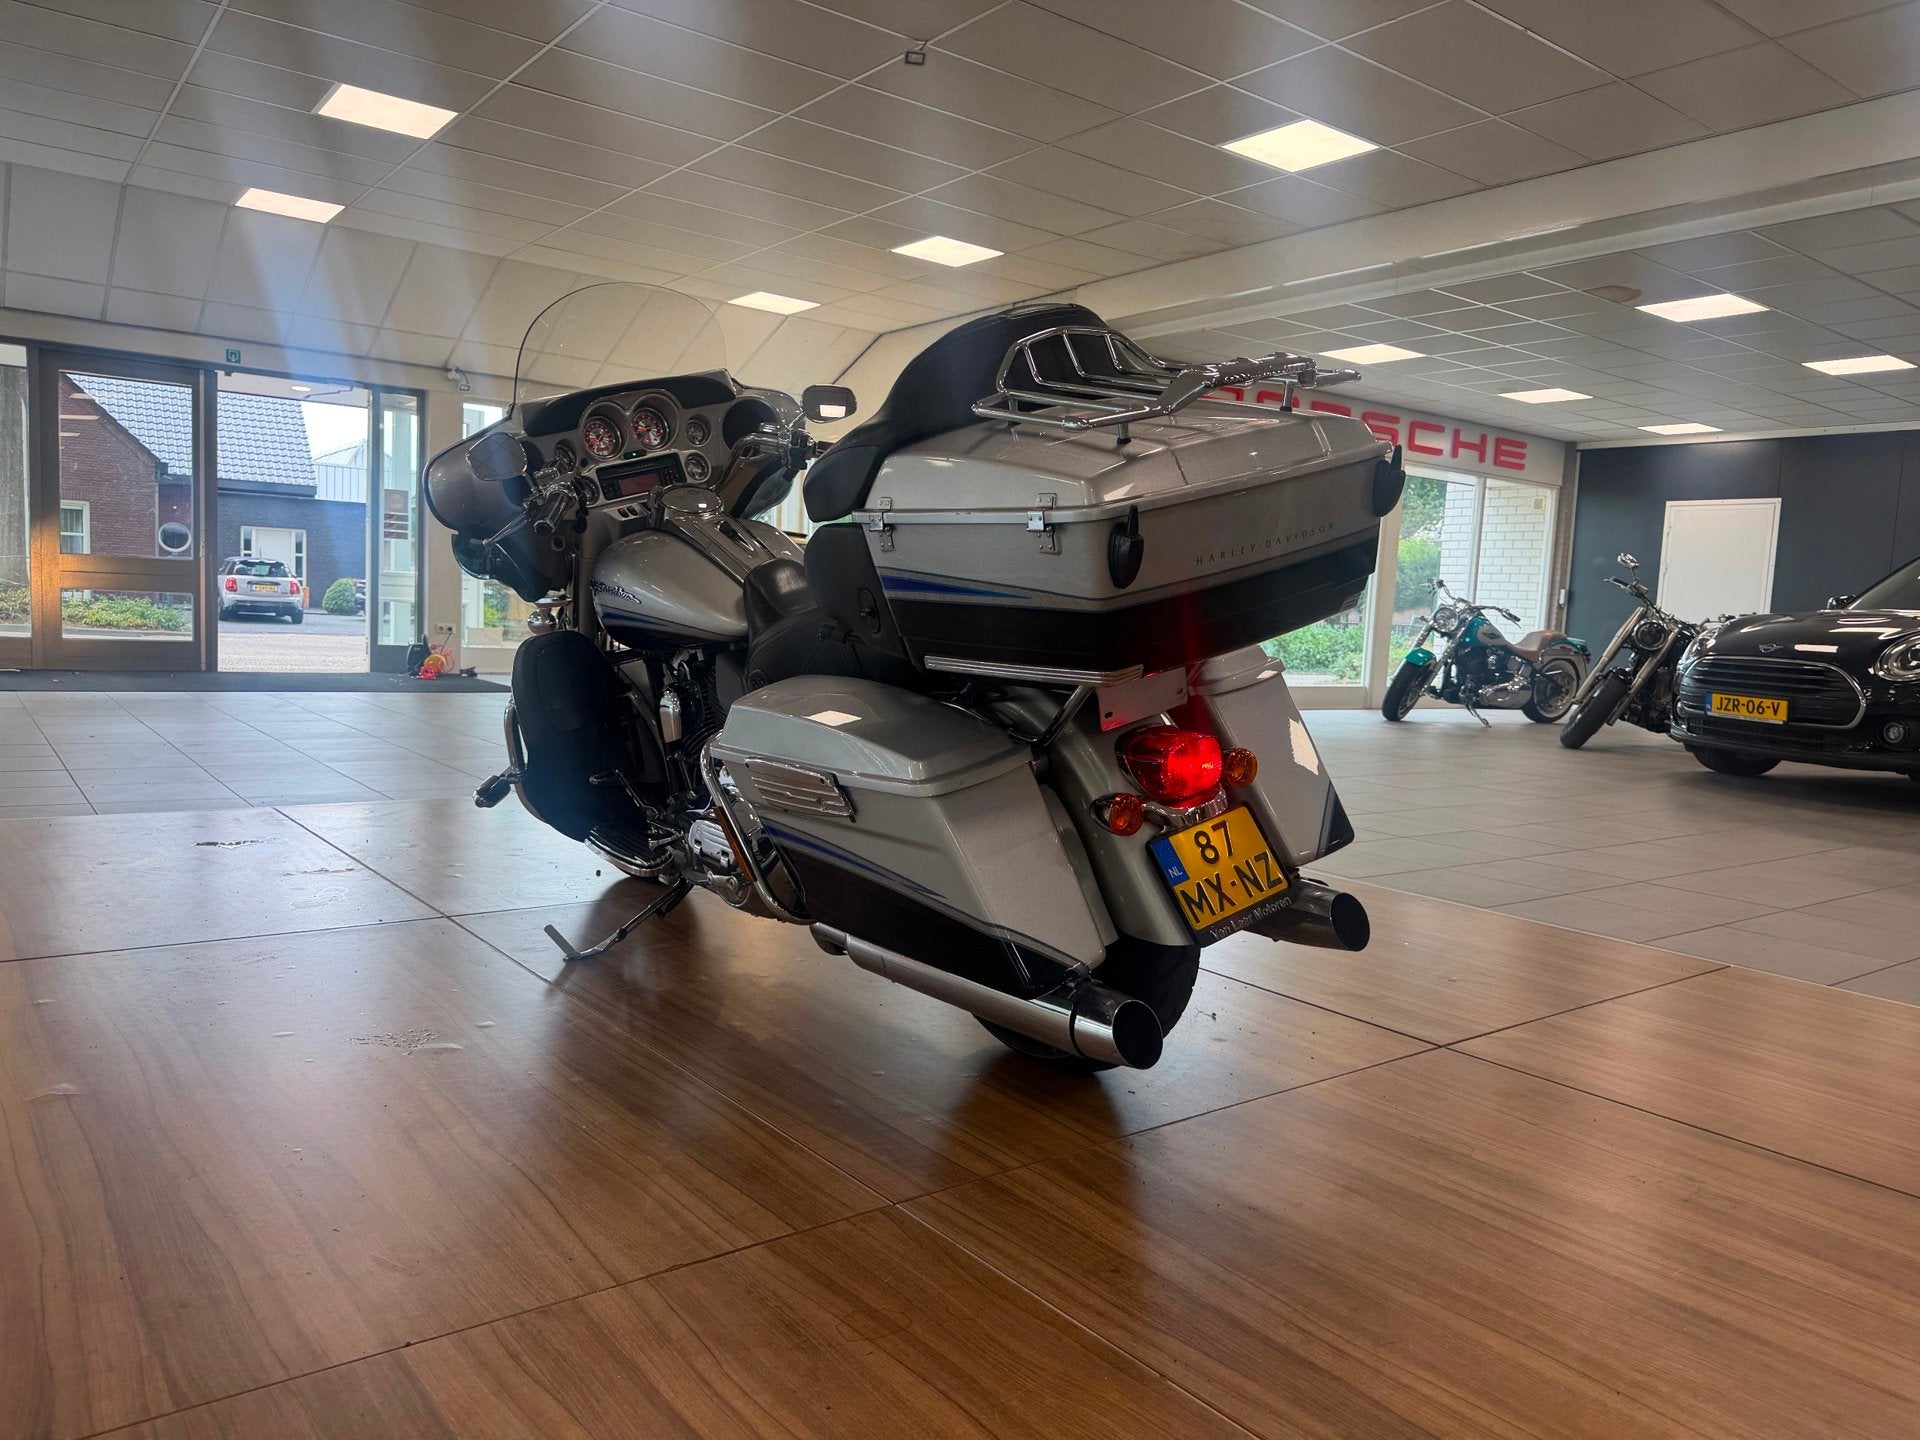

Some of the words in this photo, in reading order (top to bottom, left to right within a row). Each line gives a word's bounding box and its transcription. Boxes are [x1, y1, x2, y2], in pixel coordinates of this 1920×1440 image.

[1200, 386, 1528, 471] SCHE
[1195, 521, 1335, 566] HARLEY-DAVIDSON
[1716, 696, 1781, 717] JZR-06-V
[1194, 819, 1234, 865] 87
[1168, 866, 1183, 878] NL
[1209, 924, 1231, 940] Van
[1253, 895, 1293, 921] Motoren
